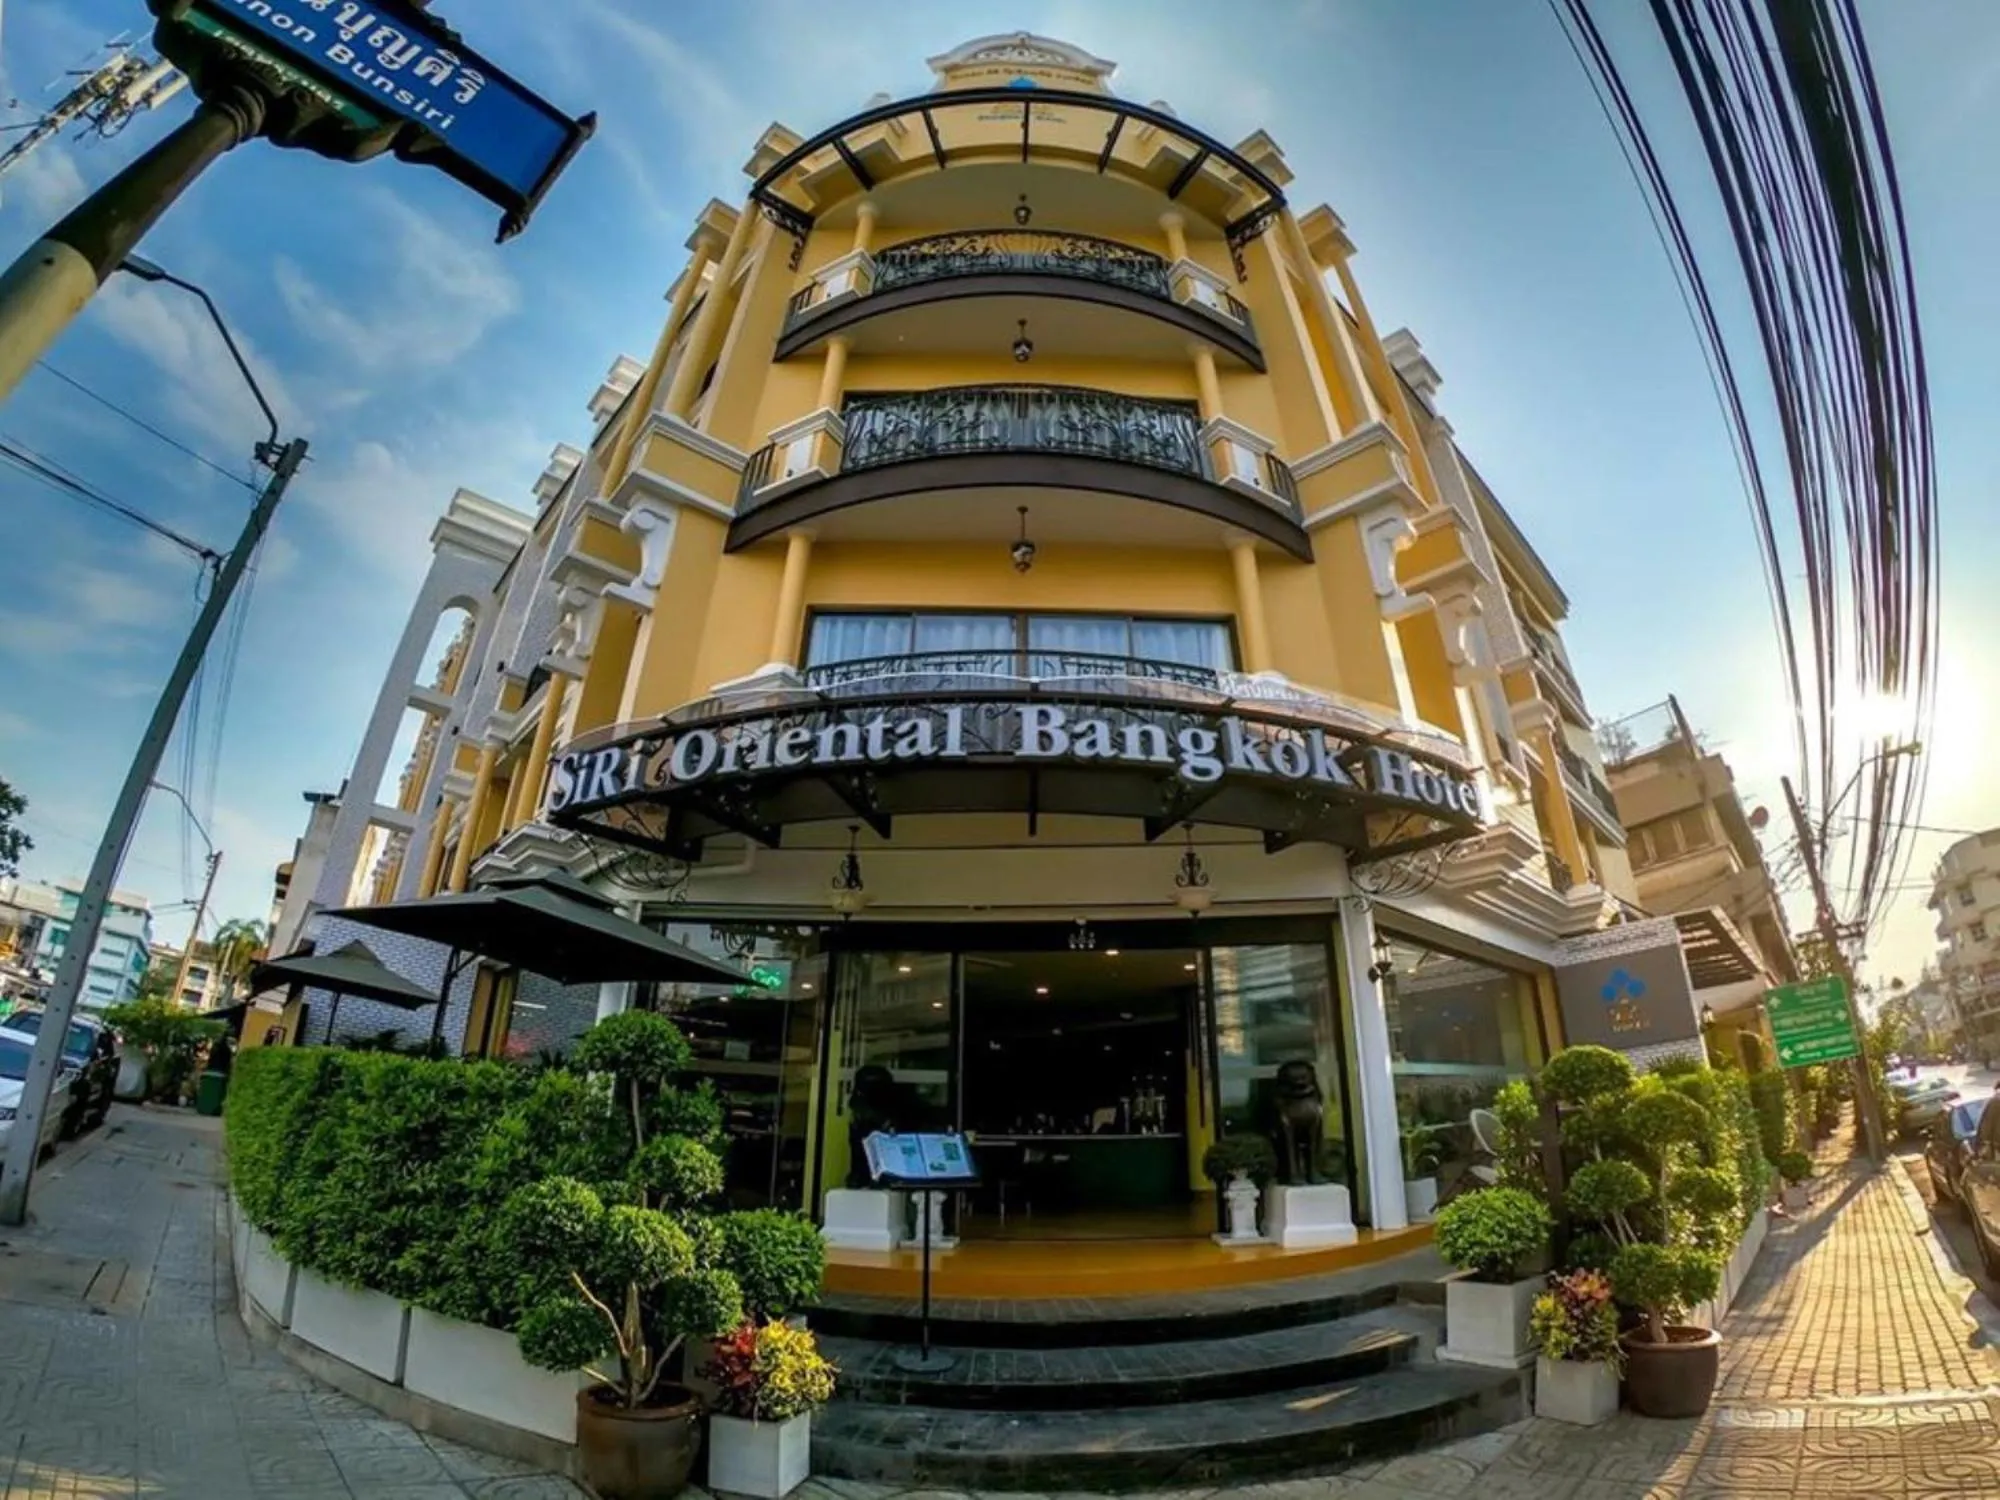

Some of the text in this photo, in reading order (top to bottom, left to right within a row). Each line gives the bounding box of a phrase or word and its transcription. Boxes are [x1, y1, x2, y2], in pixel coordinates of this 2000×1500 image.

[234, 0, 455, 129] non Bunsiri
[671, 708, 967, 781] Oriental
[1014, 704, 1353, 785] Bangkok
